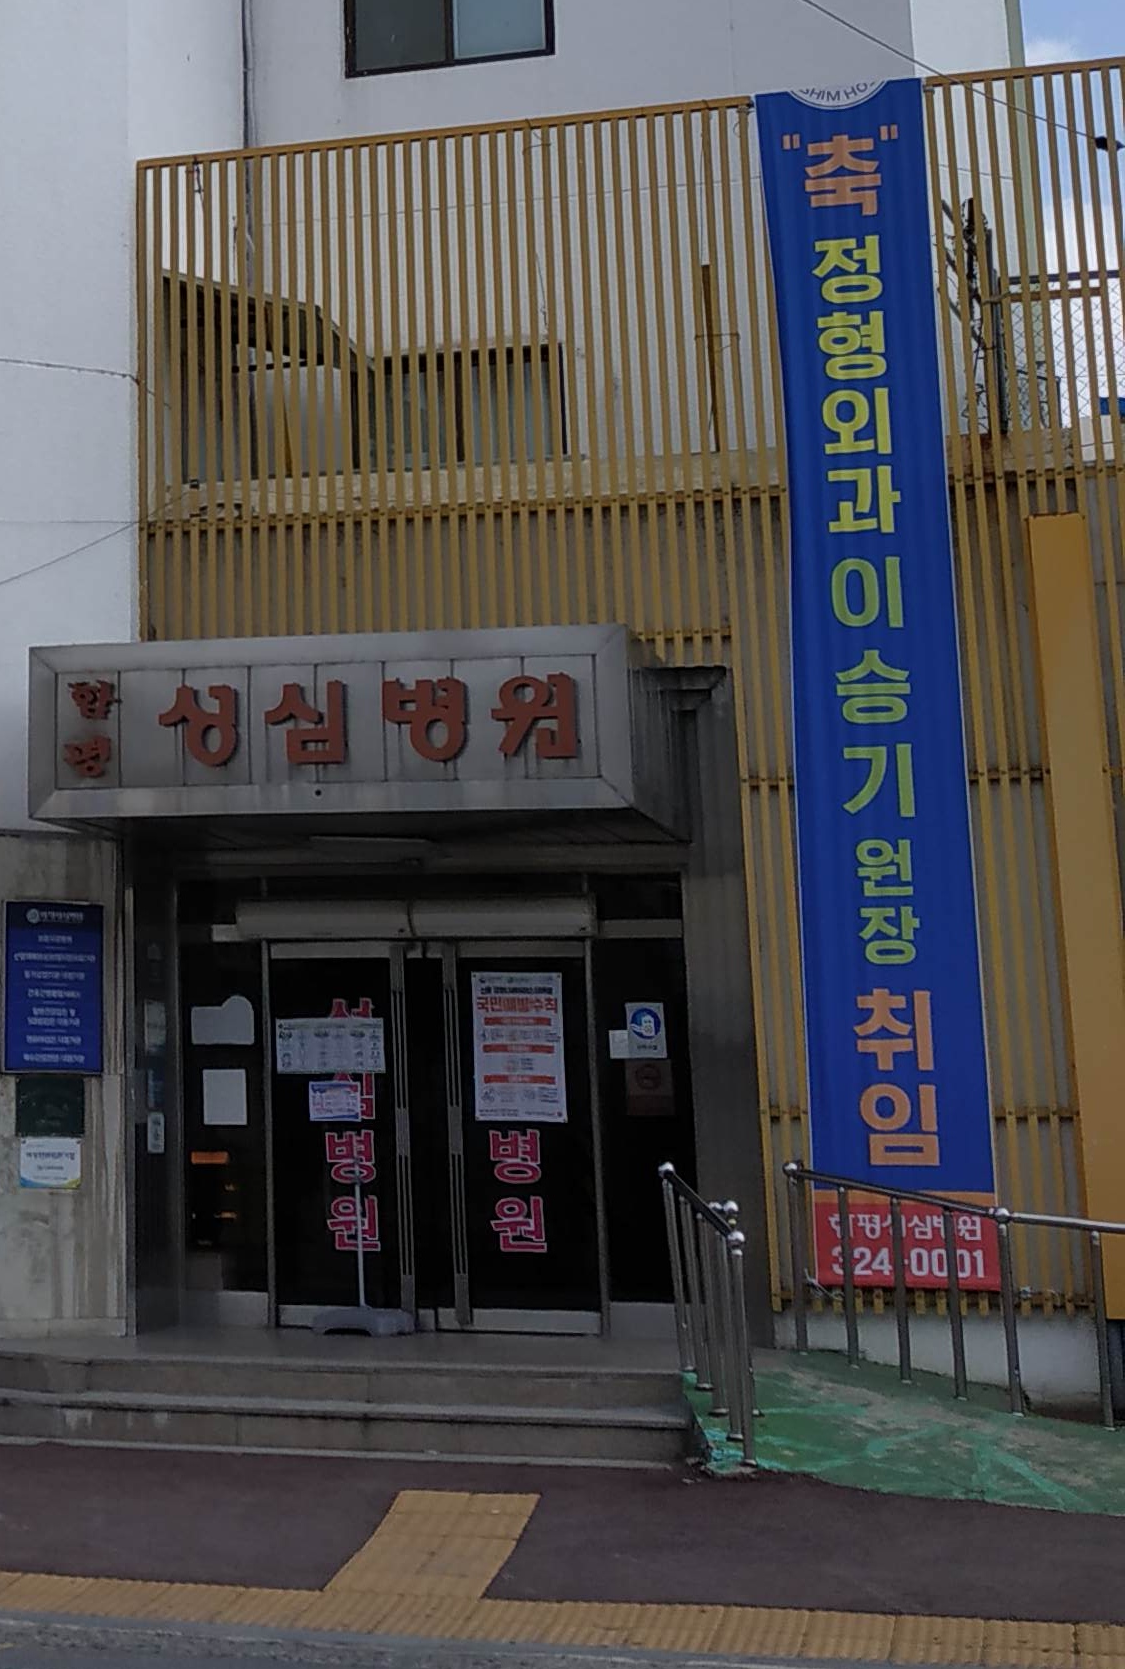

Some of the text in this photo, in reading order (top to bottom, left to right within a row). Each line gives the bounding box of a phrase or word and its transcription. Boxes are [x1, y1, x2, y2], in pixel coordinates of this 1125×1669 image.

[844, 79, 876, 100] HO
[811, 234, 902, 534] 정형외과
[64, 677, 122, 780] 함평
[158, 670, 581, 768] 성심병원
[830, 555, 916, 818] 이승기
[855, 837, 922, 966] 원장
[853, 988, 942, 1168] 취임
[488, 1128, 549, 1253] 병원
